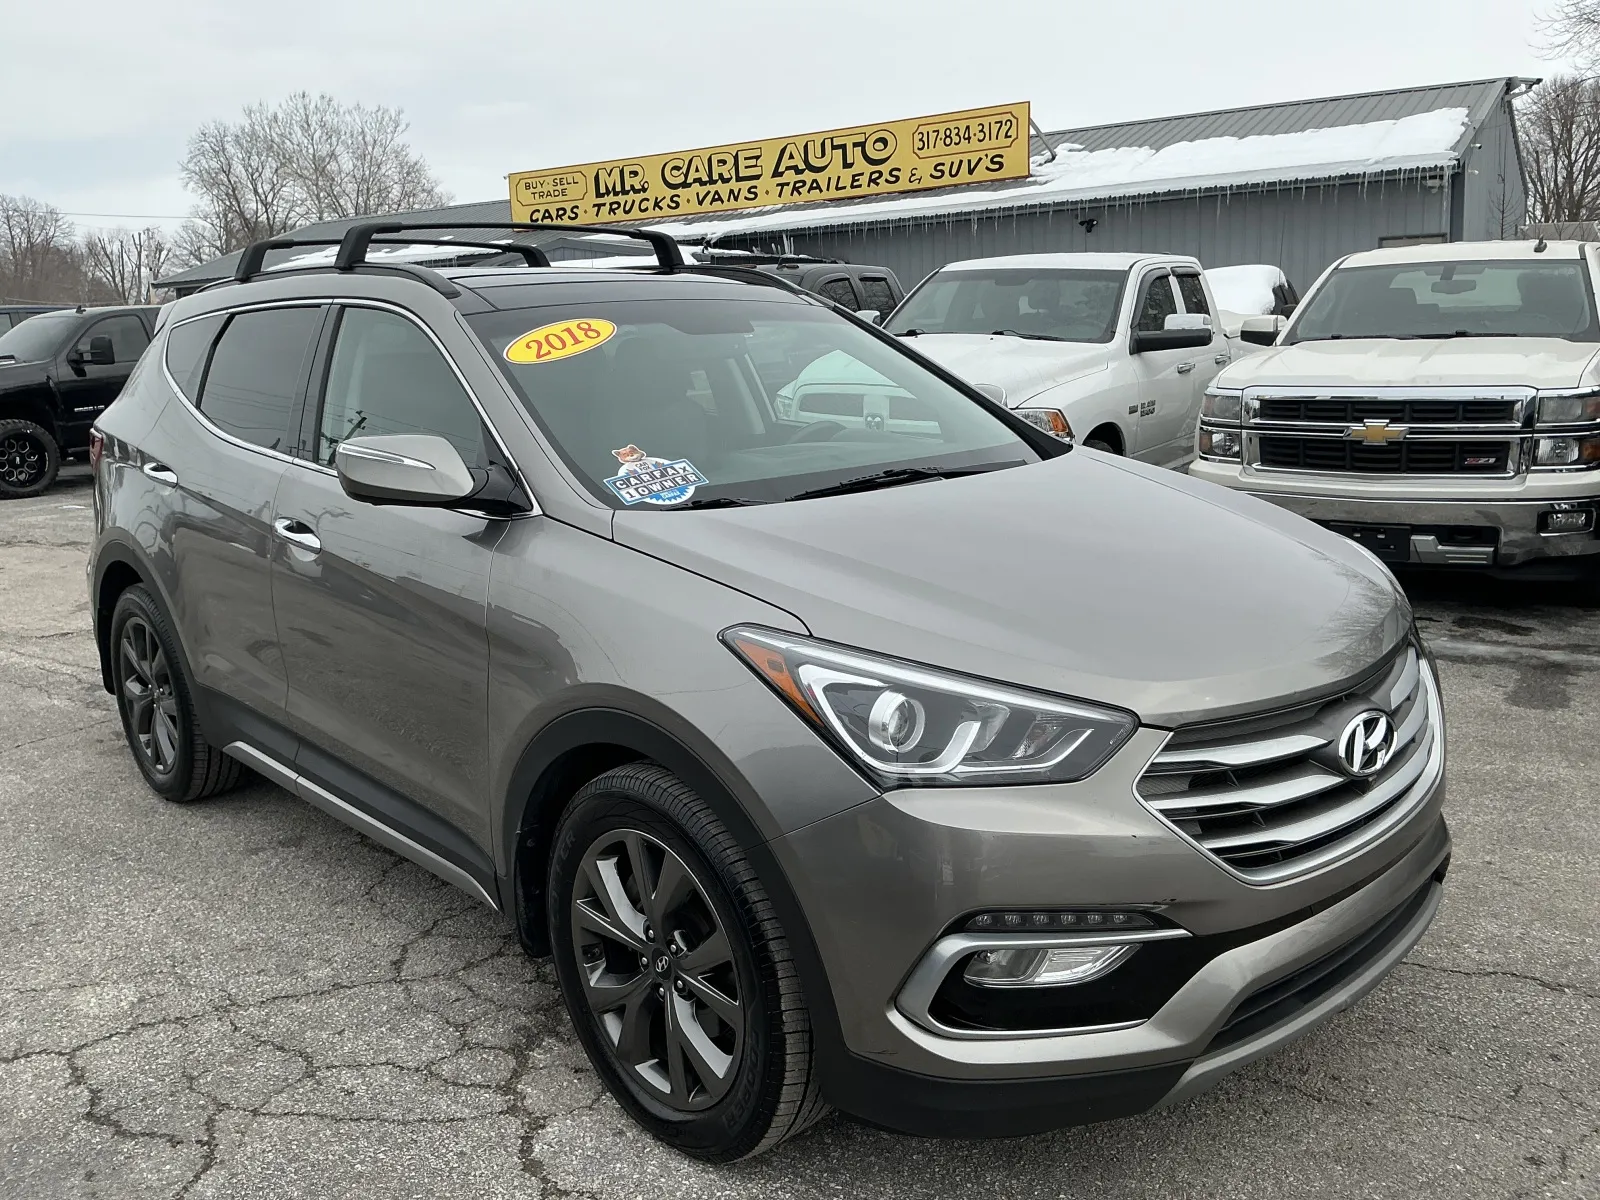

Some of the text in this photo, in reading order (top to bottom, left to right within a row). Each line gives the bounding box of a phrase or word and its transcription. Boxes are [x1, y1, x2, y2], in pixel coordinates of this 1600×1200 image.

[594, 129, 898, 198] MR. CARE AUTO
[524, 176, 579, 190] BUY SELL
[529, 153, 1004, 223] CARS TRUCKS VANS TRAILERS & SUV'S
[531, 188, 568, 200] TRADE
[525, 321, 601, 360] 2018
[615, 465, 690, 489] CARFAX
[625, 490, 636, 499] 1
[637, 474, 699, 496] OWNER
